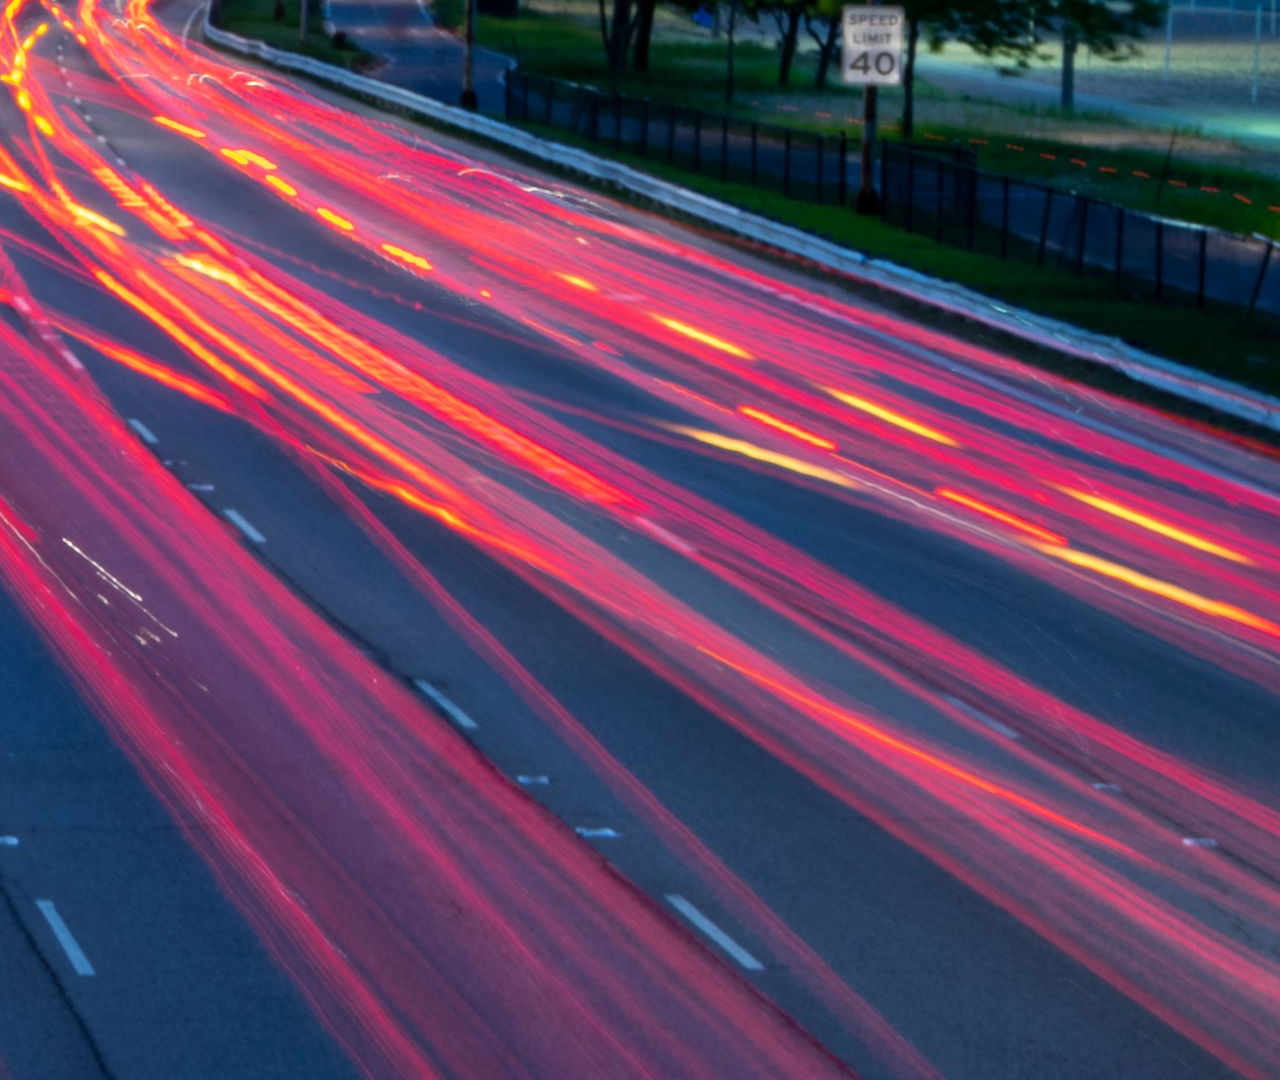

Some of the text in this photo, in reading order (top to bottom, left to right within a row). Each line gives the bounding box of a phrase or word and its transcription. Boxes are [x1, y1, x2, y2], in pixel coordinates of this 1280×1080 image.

[849, 14, 898, 26] SPEED
[852, 33, 893, 44] LIMIT
[849, 51, 896, 75] 40
